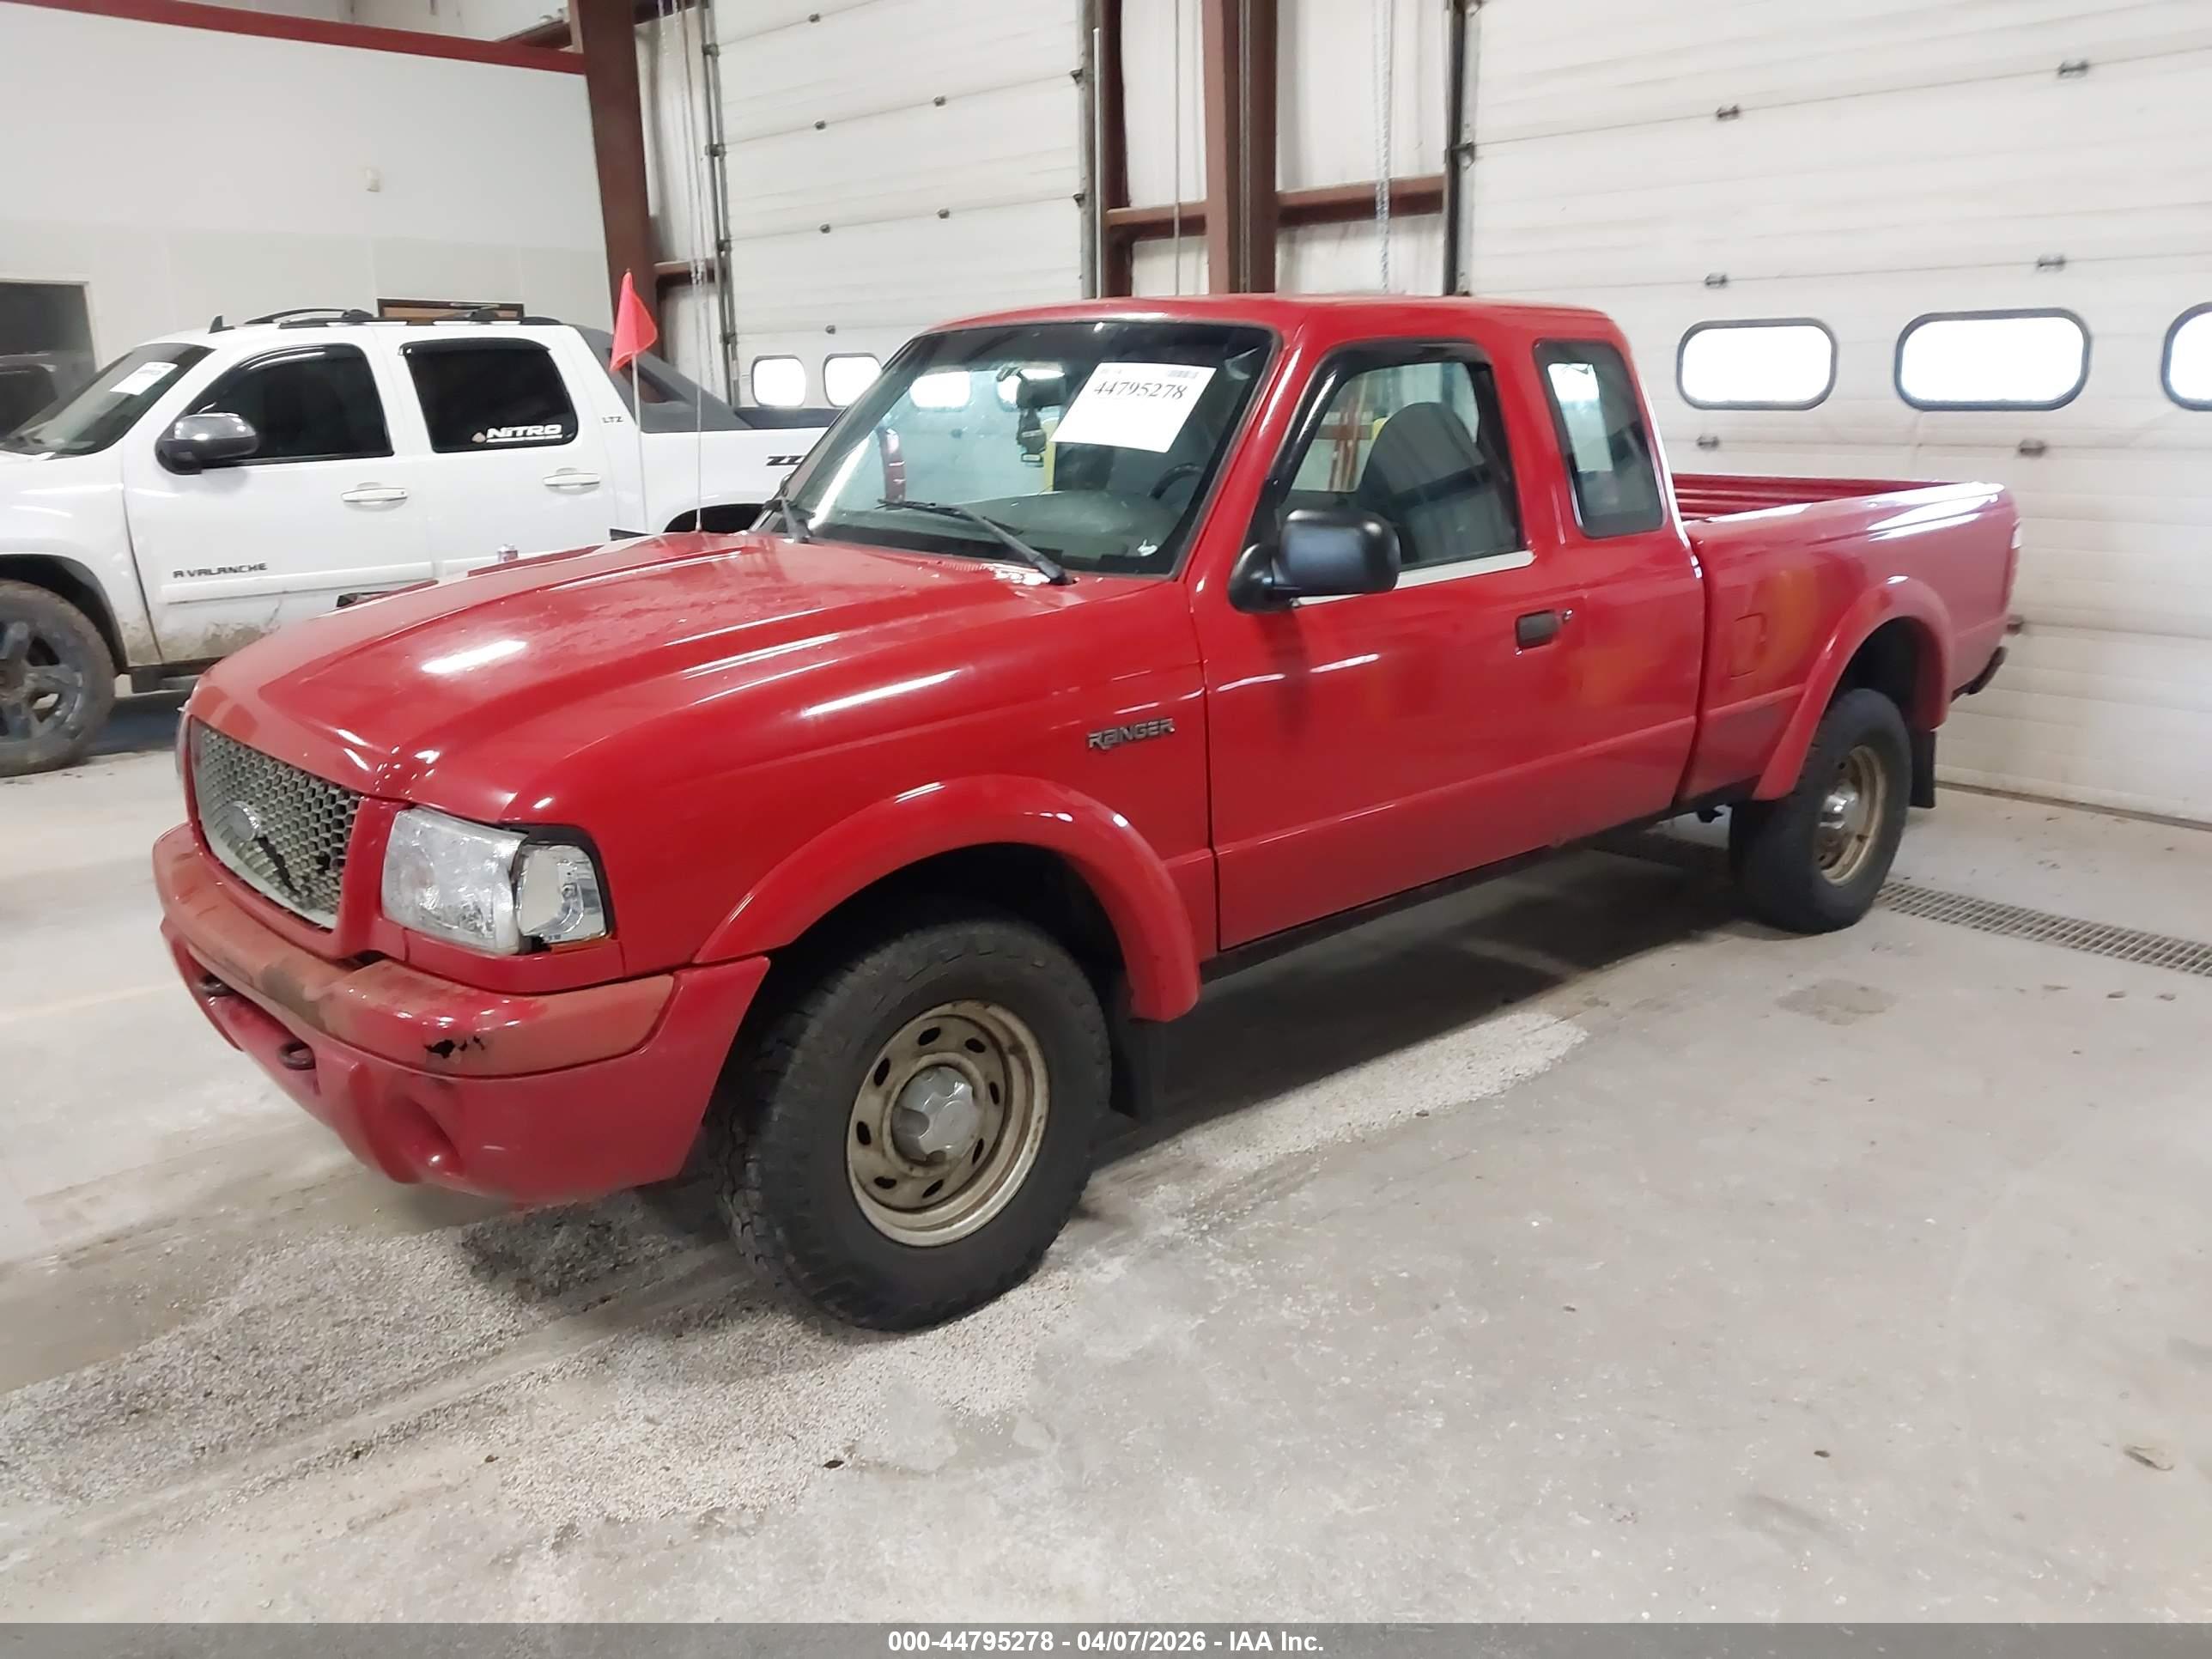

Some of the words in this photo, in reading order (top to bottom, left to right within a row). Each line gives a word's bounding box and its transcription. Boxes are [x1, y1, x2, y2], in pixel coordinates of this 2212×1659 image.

[1094, 380, 1188, 399] 44795278
[486, 423, 562, 439] NITRO
[173, 562, 268, 578] AVALANCHE
[1087, 718, 1176, 750] RANGER
